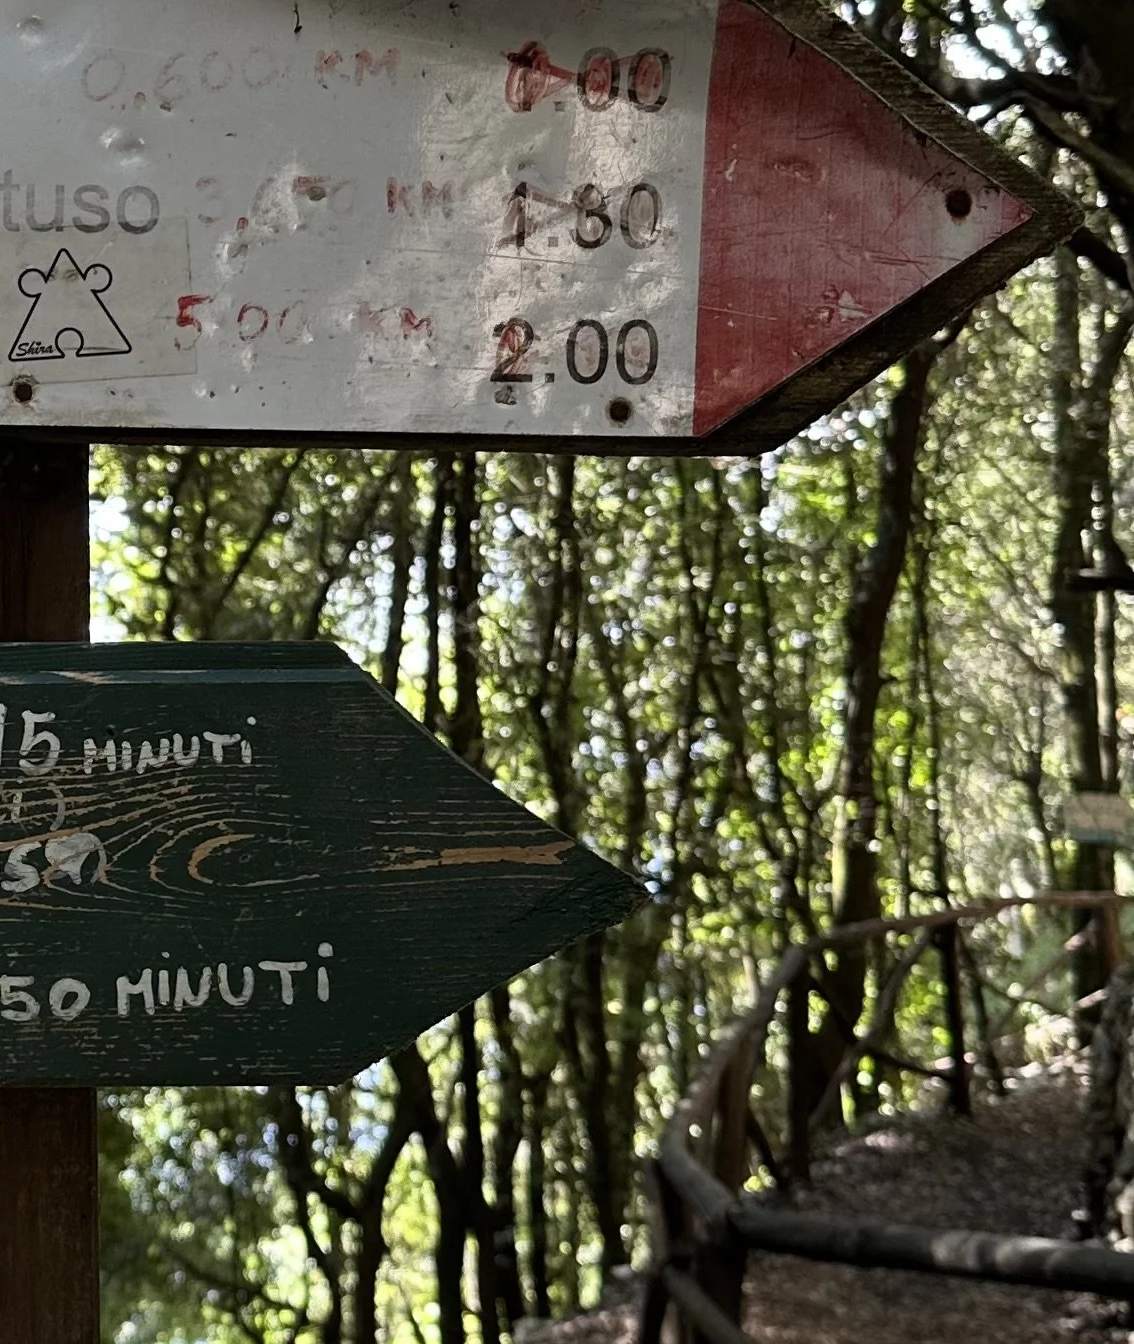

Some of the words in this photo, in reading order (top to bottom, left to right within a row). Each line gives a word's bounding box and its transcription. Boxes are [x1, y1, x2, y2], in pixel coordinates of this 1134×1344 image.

[315, 47, 402, 87] KM
[16, 341, 53, 356] Shira
[490, 318, 659, 385] 2.00
[0, 974, 91, 1023] 50
